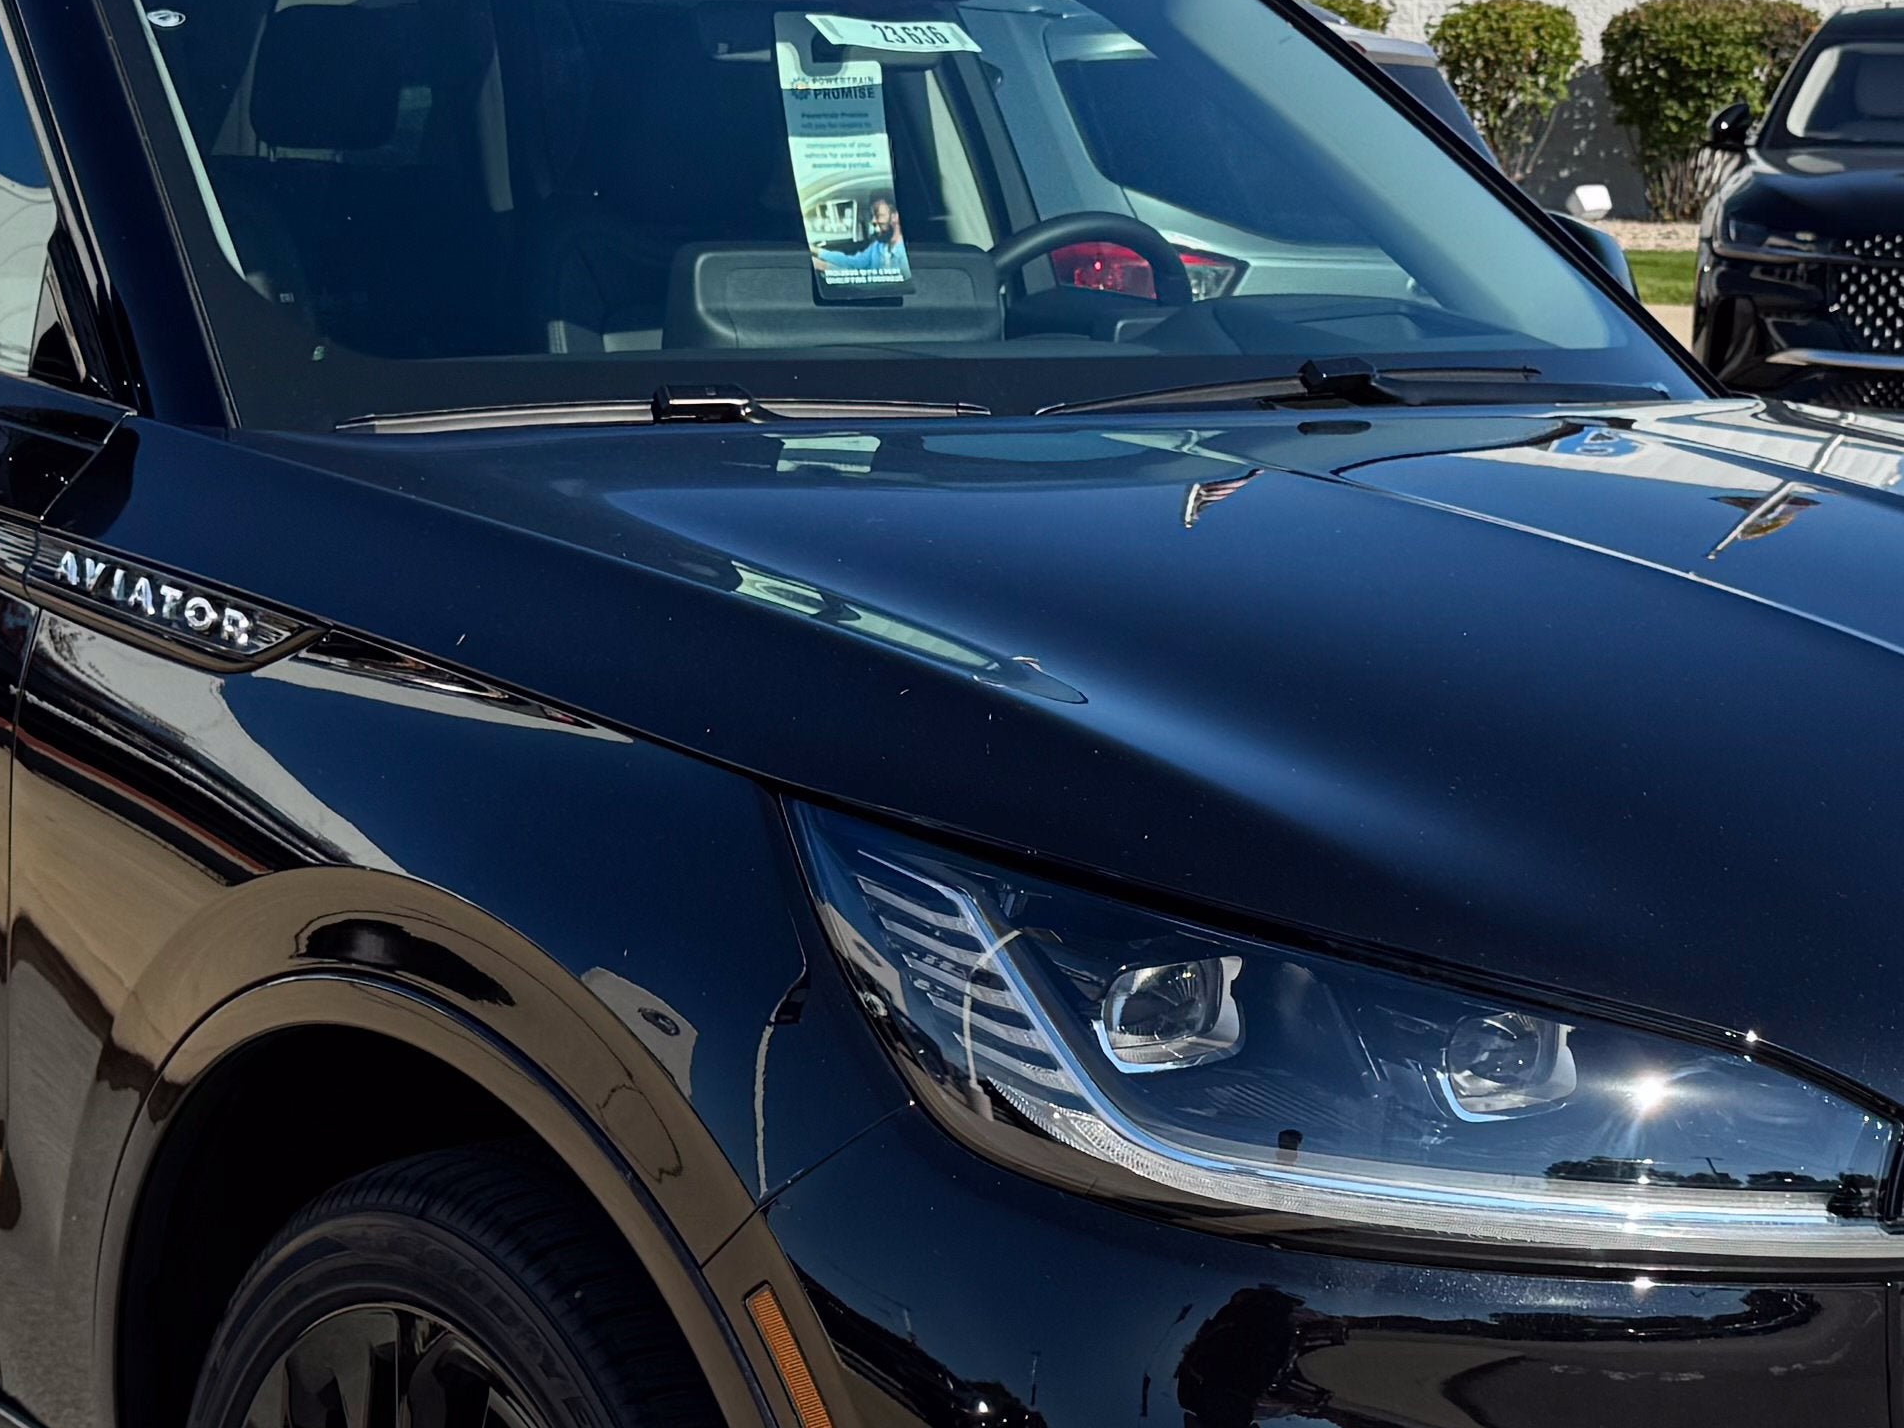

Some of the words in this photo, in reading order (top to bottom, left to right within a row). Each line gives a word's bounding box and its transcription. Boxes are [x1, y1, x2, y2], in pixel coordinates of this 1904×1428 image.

[871, 23, 950, 46] 23636
[812, 76, 874, 86] POWERTRAIN
[813, 87, 876, 100] PROMISE
[56, 550, 254, 646] AVIATOR
